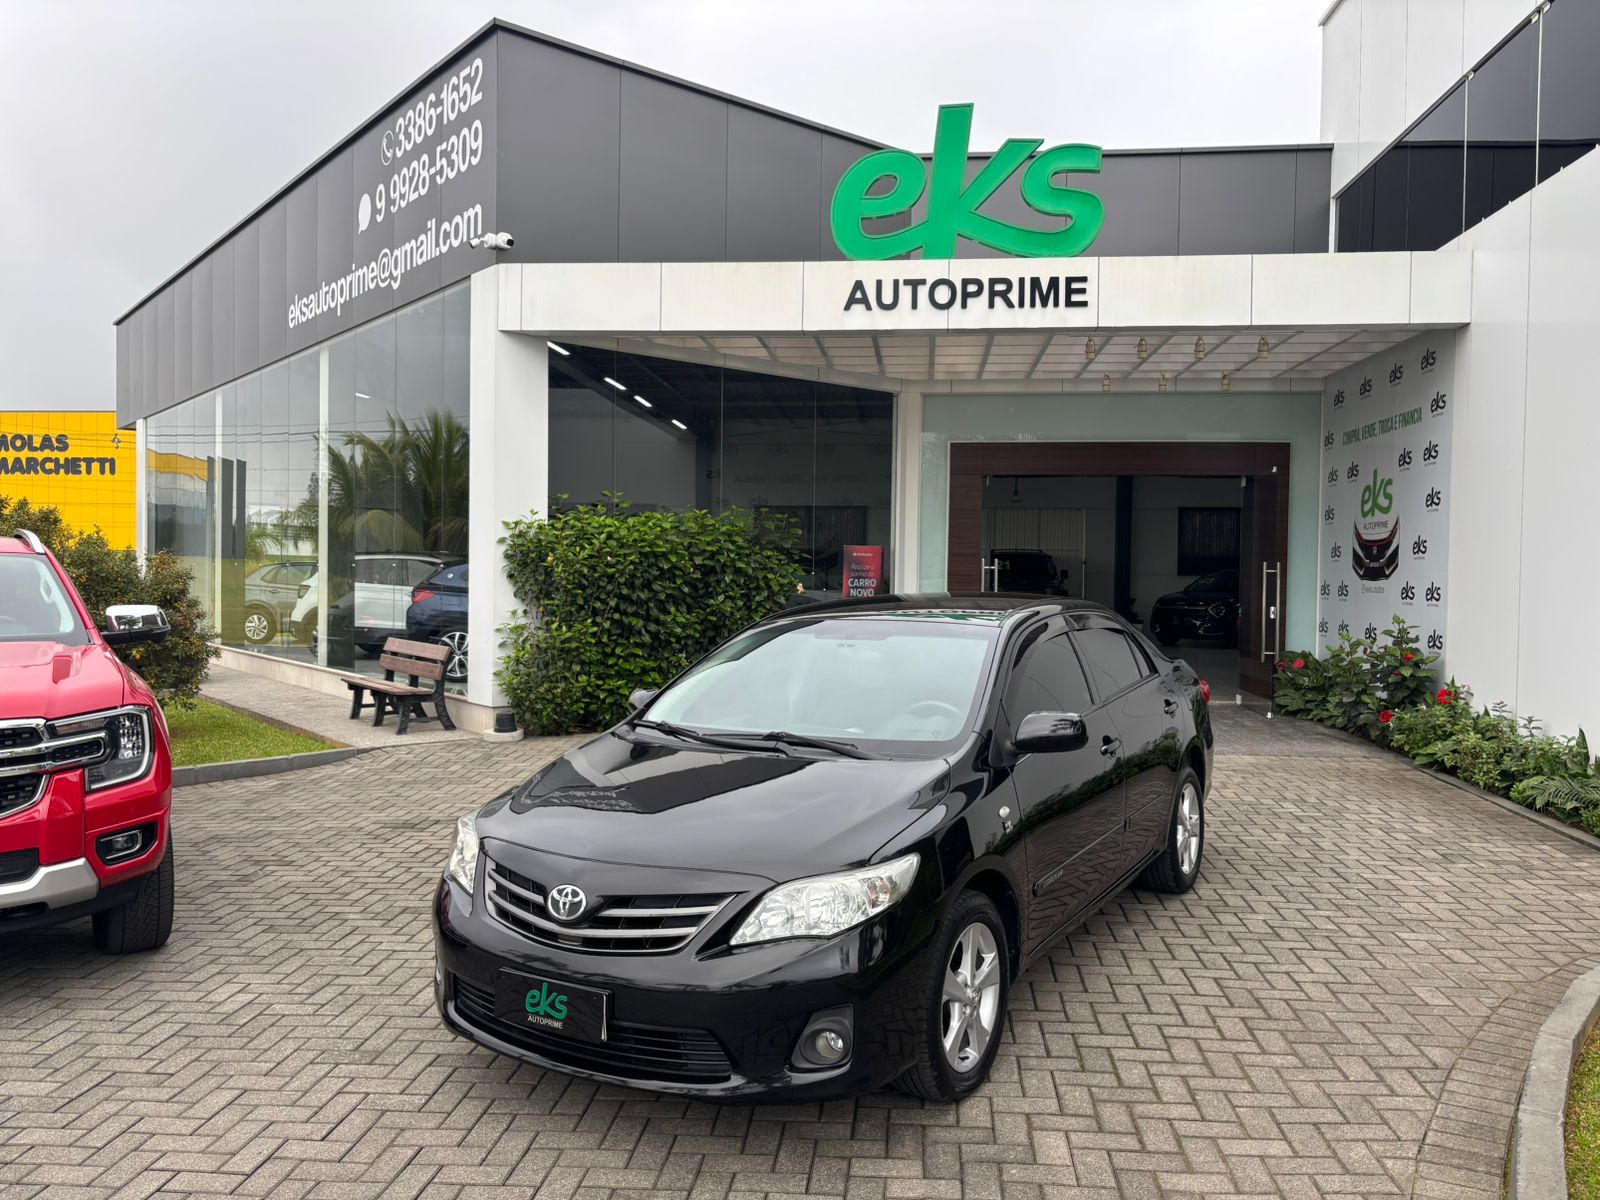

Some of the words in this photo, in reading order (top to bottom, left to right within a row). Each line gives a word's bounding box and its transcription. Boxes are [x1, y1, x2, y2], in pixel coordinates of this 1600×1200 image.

[395, 57, 483, 158] 3386-1652
[375, 183, 386, 222] 9
[390, 119, 483, 213] 9928-5309
[831, 102, 1105, 261] eks
[288, 203, 482, 328] eksautoprime@gmail.com
[843, 275, 1089, 311] AUTOPRIME
[1430, 391, 1446, 413] eks
[1398, 447, 1412, 467] eks
[1423, 440, 1439, 462] eks
[1361, 469, 1393, 518] eks
[1425, 486, 1441, 507] eks
[1413, 535, 1427, 555] eks
[848, 578, 877, 587] CARRO
[850, 588, 875, 597] NOVO
[1401, 581, 1415, 600] eks
[1425, 582, 1441, 601] eks
[1427, 629, 1443, 650] eks
[525, 982, 568, 1019] eks
[527, 1015, 564, 1029] AUTOPRIME
